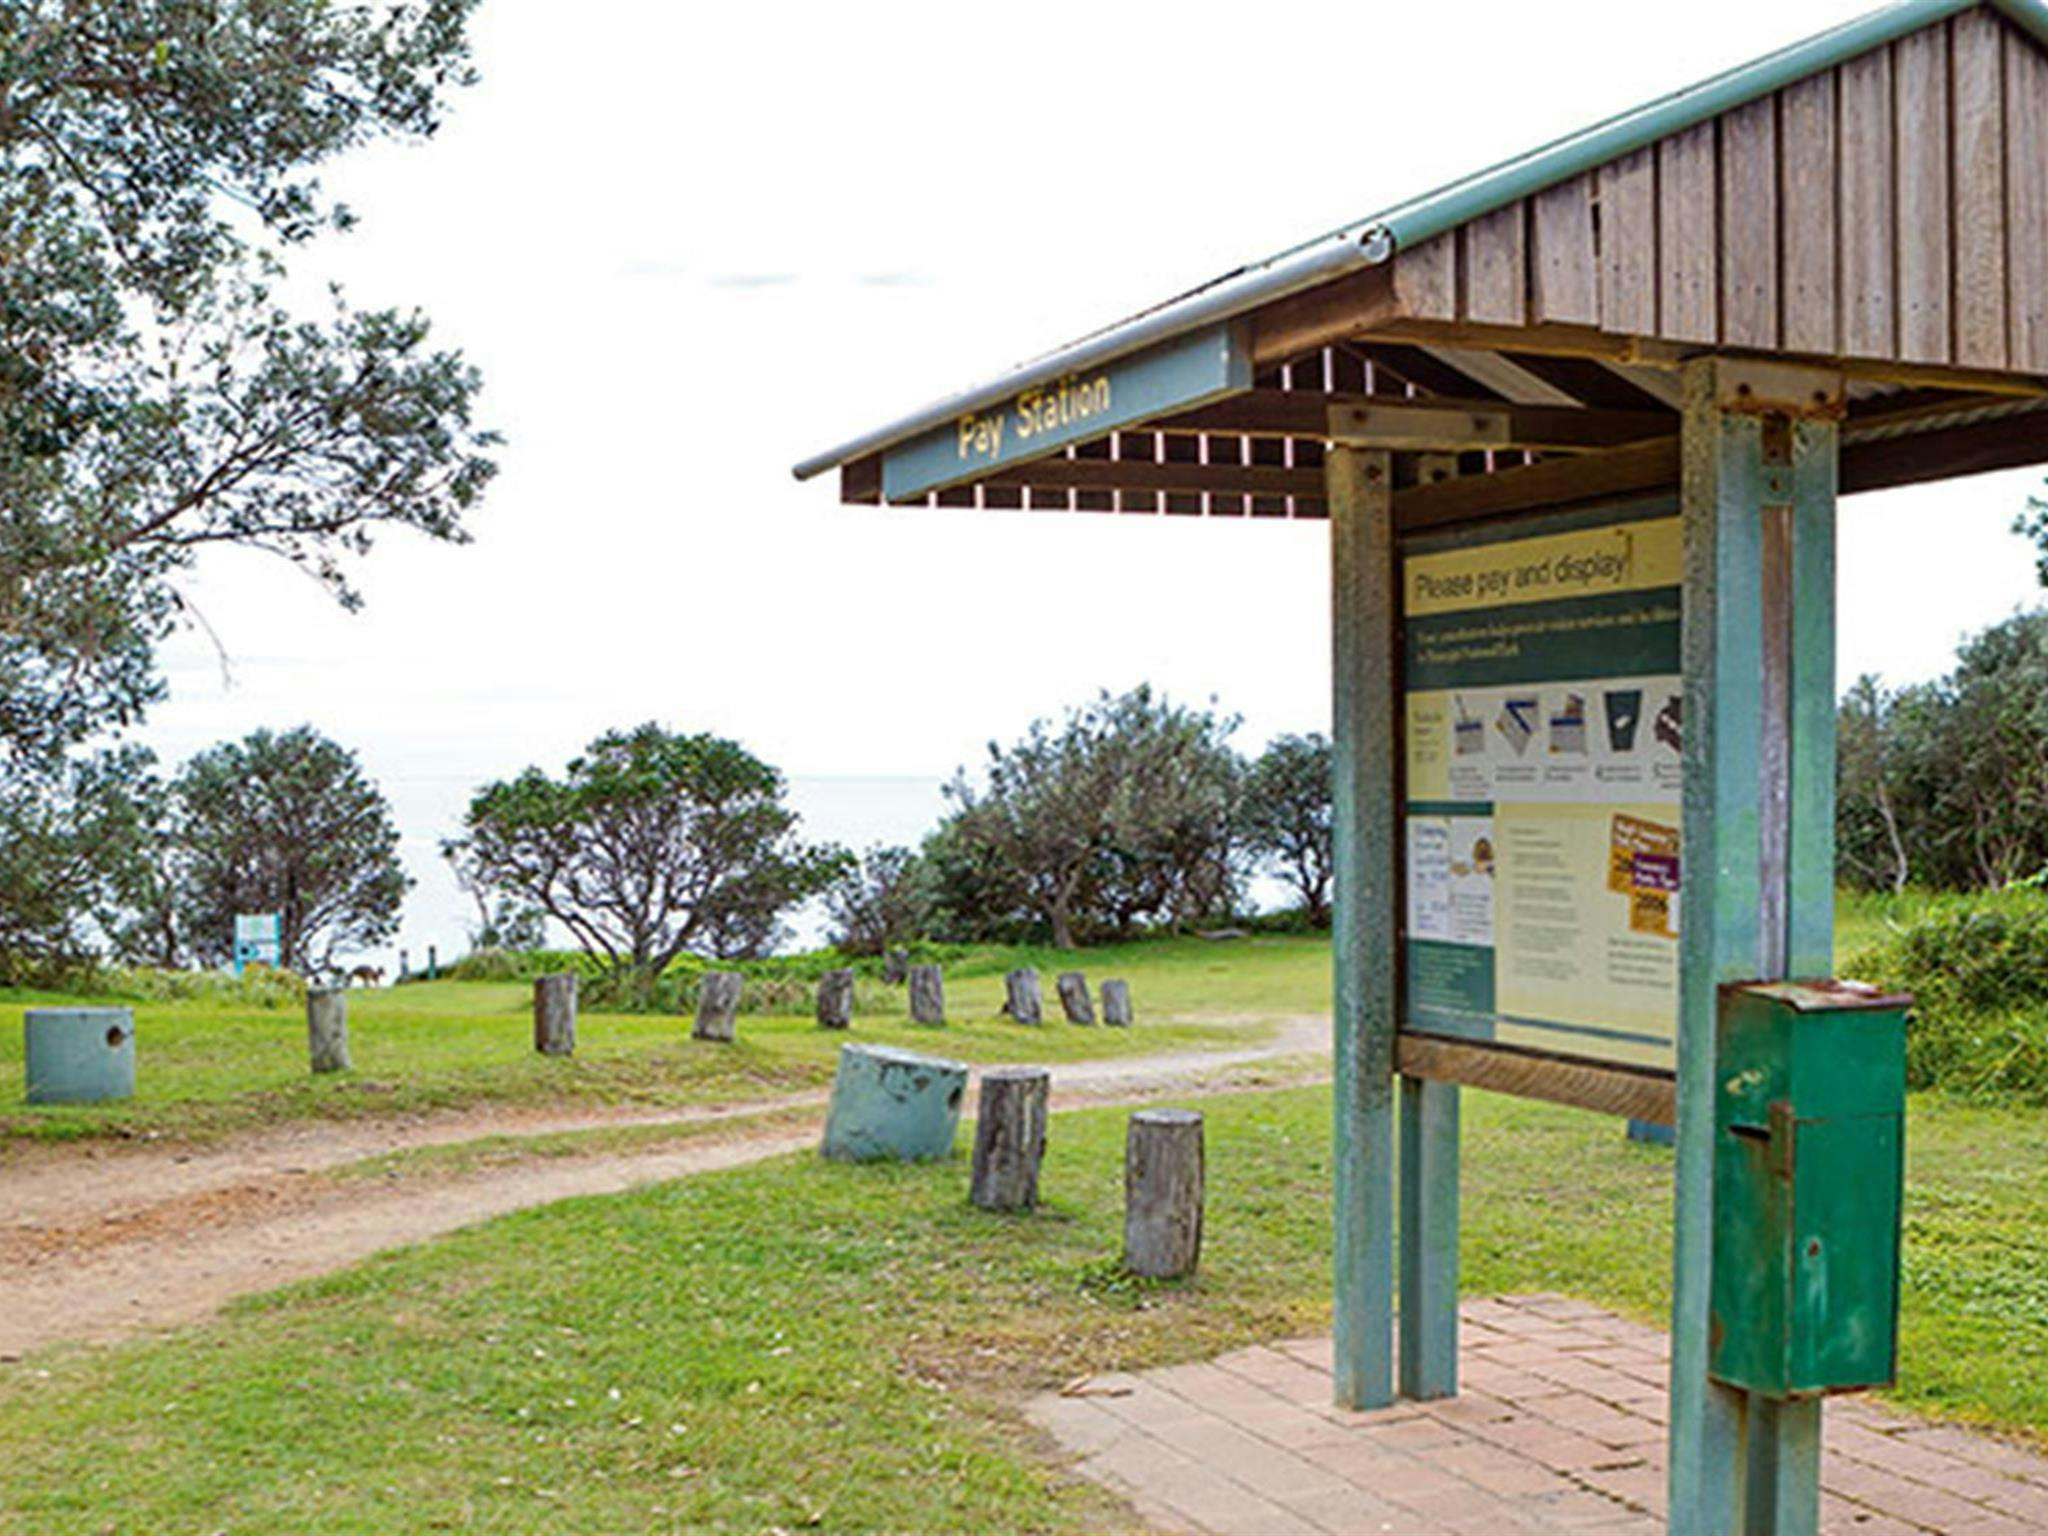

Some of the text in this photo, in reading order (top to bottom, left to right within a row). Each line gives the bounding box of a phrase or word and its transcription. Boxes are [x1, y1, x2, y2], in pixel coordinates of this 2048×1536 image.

[958, 374, 1111, 460] Pay Station
[1415, 550, 1626, 599] Please pay and display
